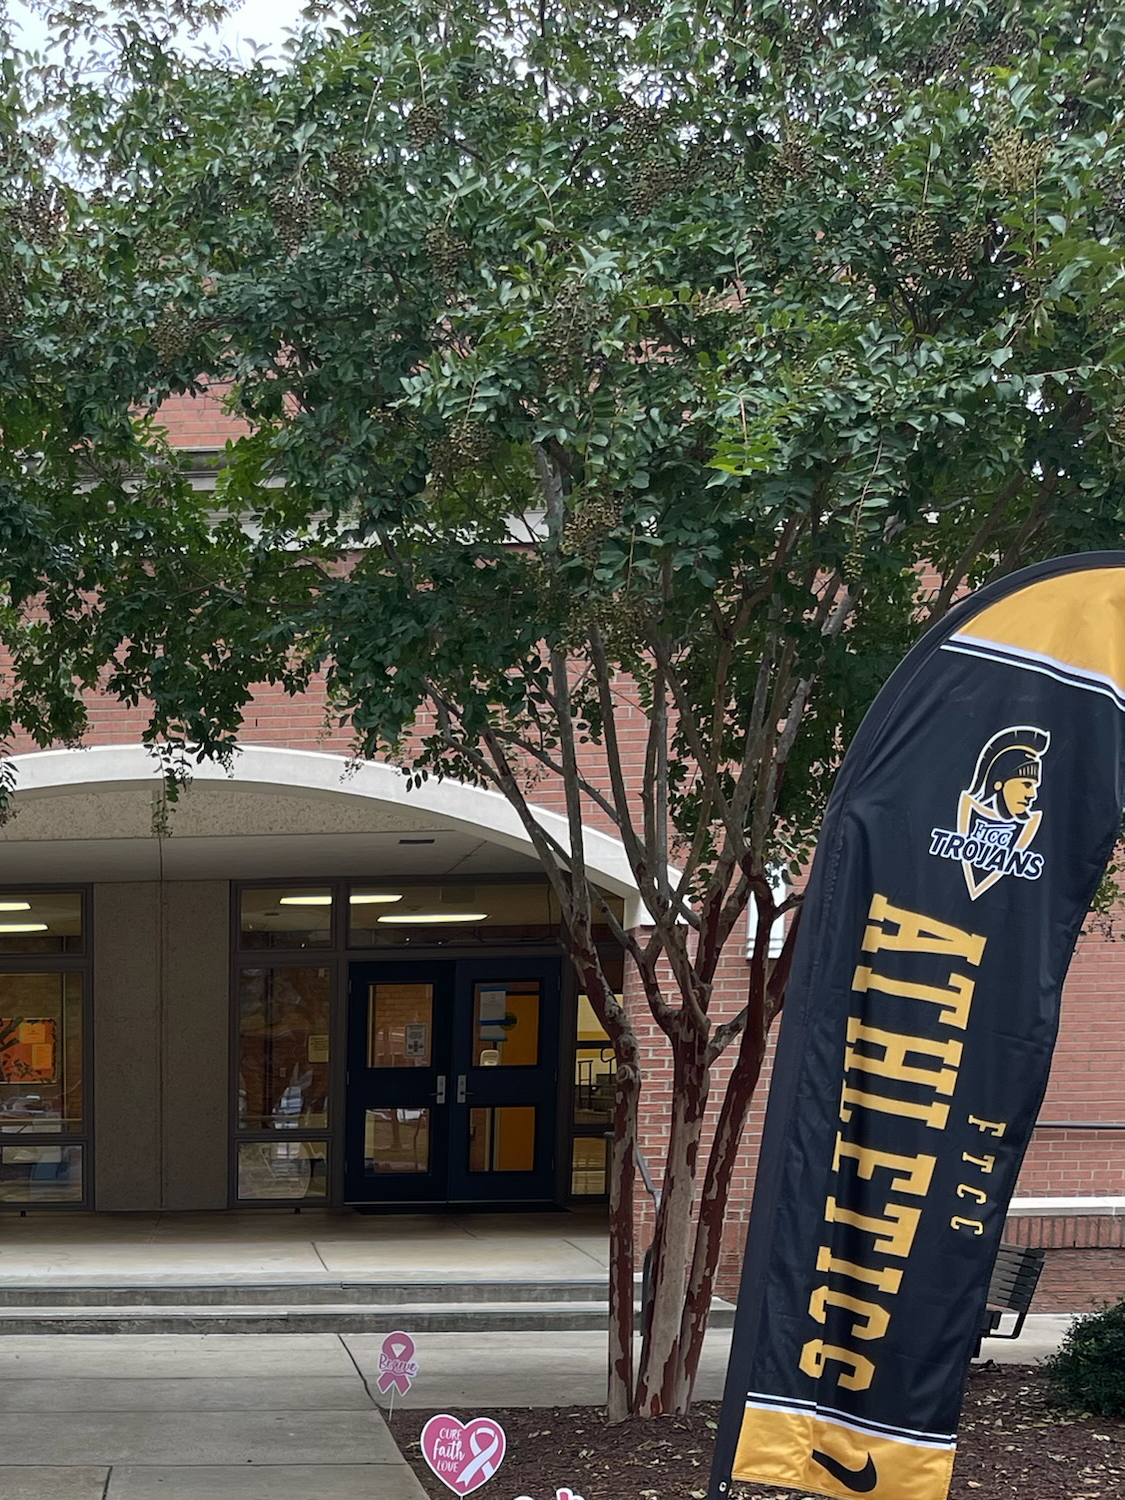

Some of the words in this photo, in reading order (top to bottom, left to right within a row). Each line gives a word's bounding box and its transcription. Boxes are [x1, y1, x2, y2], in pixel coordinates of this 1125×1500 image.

[929, 828, 1045, 880] TROJANS
[798, 893, 988, 1392] ATHLETICS
[950, 1114, 1007, 1237] FTCC
[439, 1427, 463, 1441] CURE
[436, 1460, 459, 1473] LOVE
